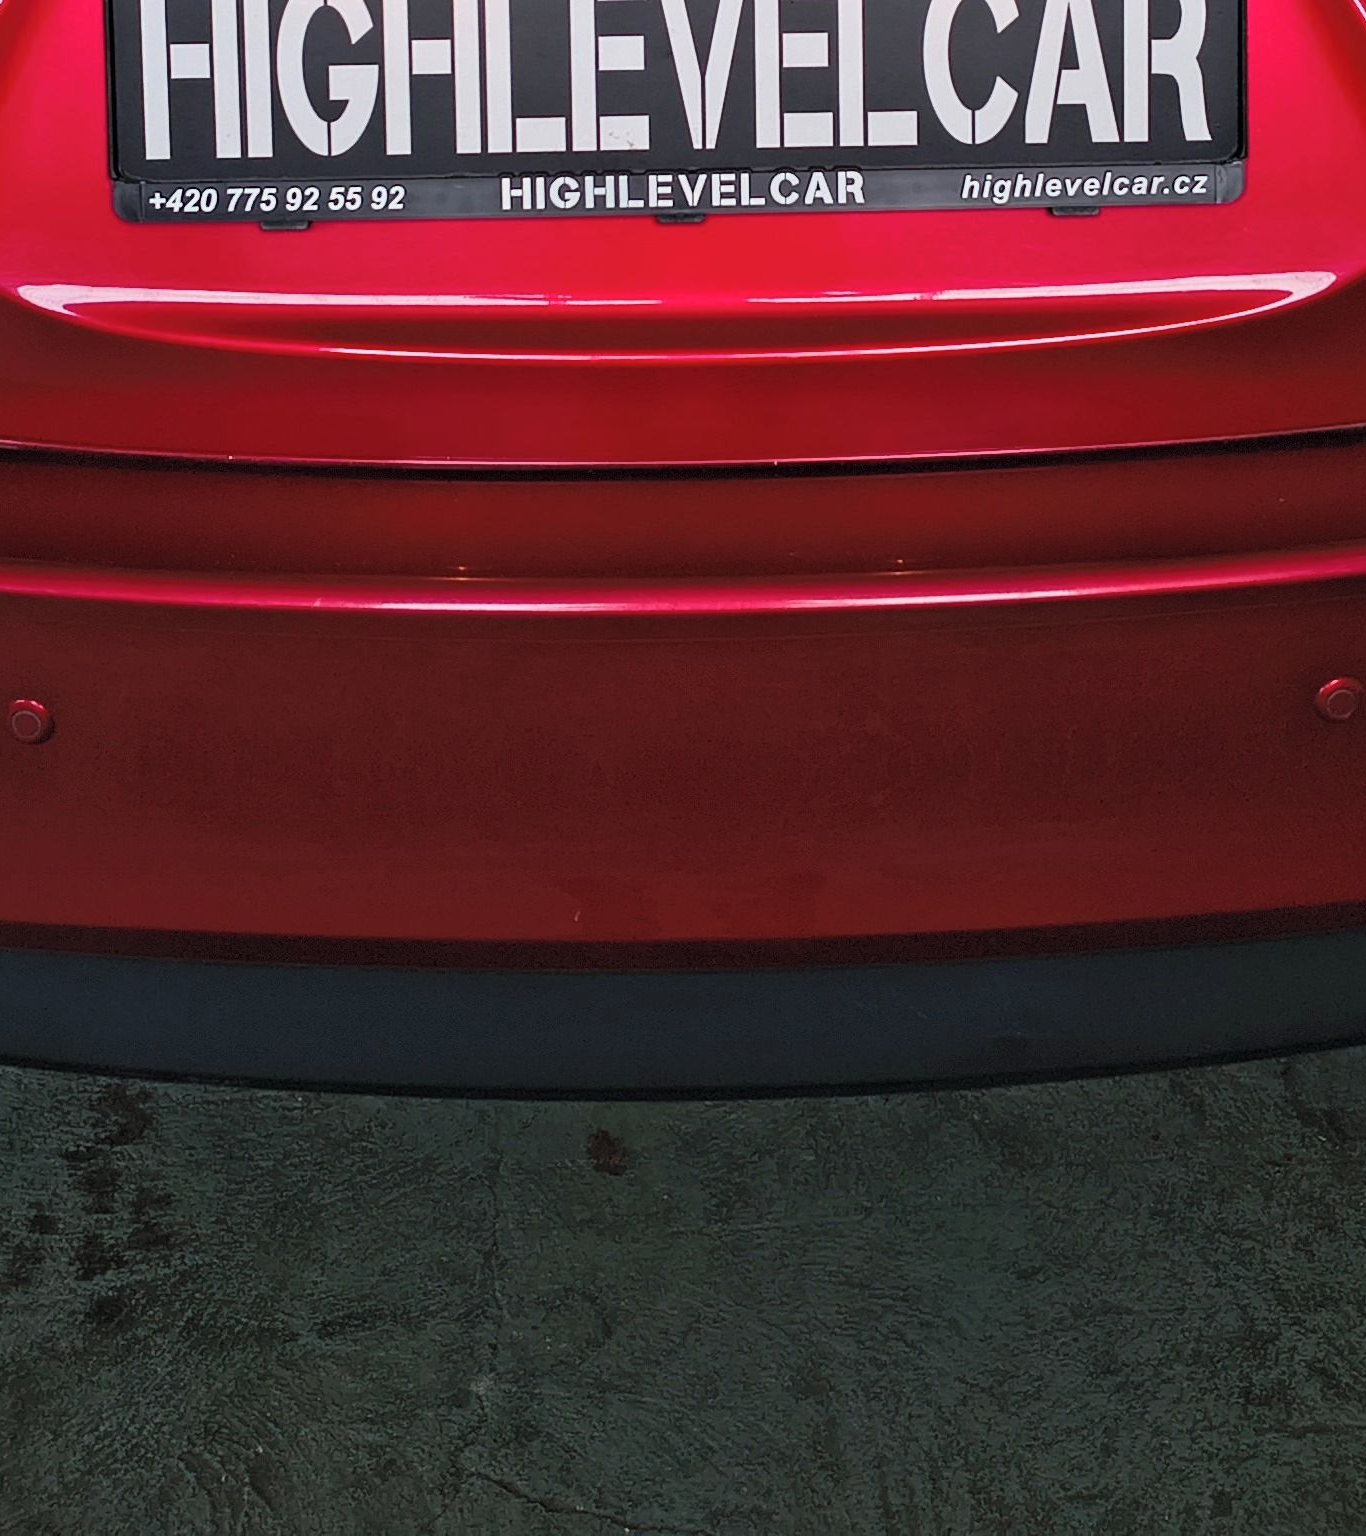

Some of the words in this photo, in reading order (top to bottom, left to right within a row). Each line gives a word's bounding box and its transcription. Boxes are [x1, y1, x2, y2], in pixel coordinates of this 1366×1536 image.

[148, 187, 218, 213] +420
[225, 187, 278, 212] 775
[285, 186, 320, 211] 92
[327, 186, 363, 211] 55
[370, 185, 406, 210] 92
[500, 170, 866, 210] HIGHLEVELCAR
[961, 172, 1208, 205] highlevelcar.cz
